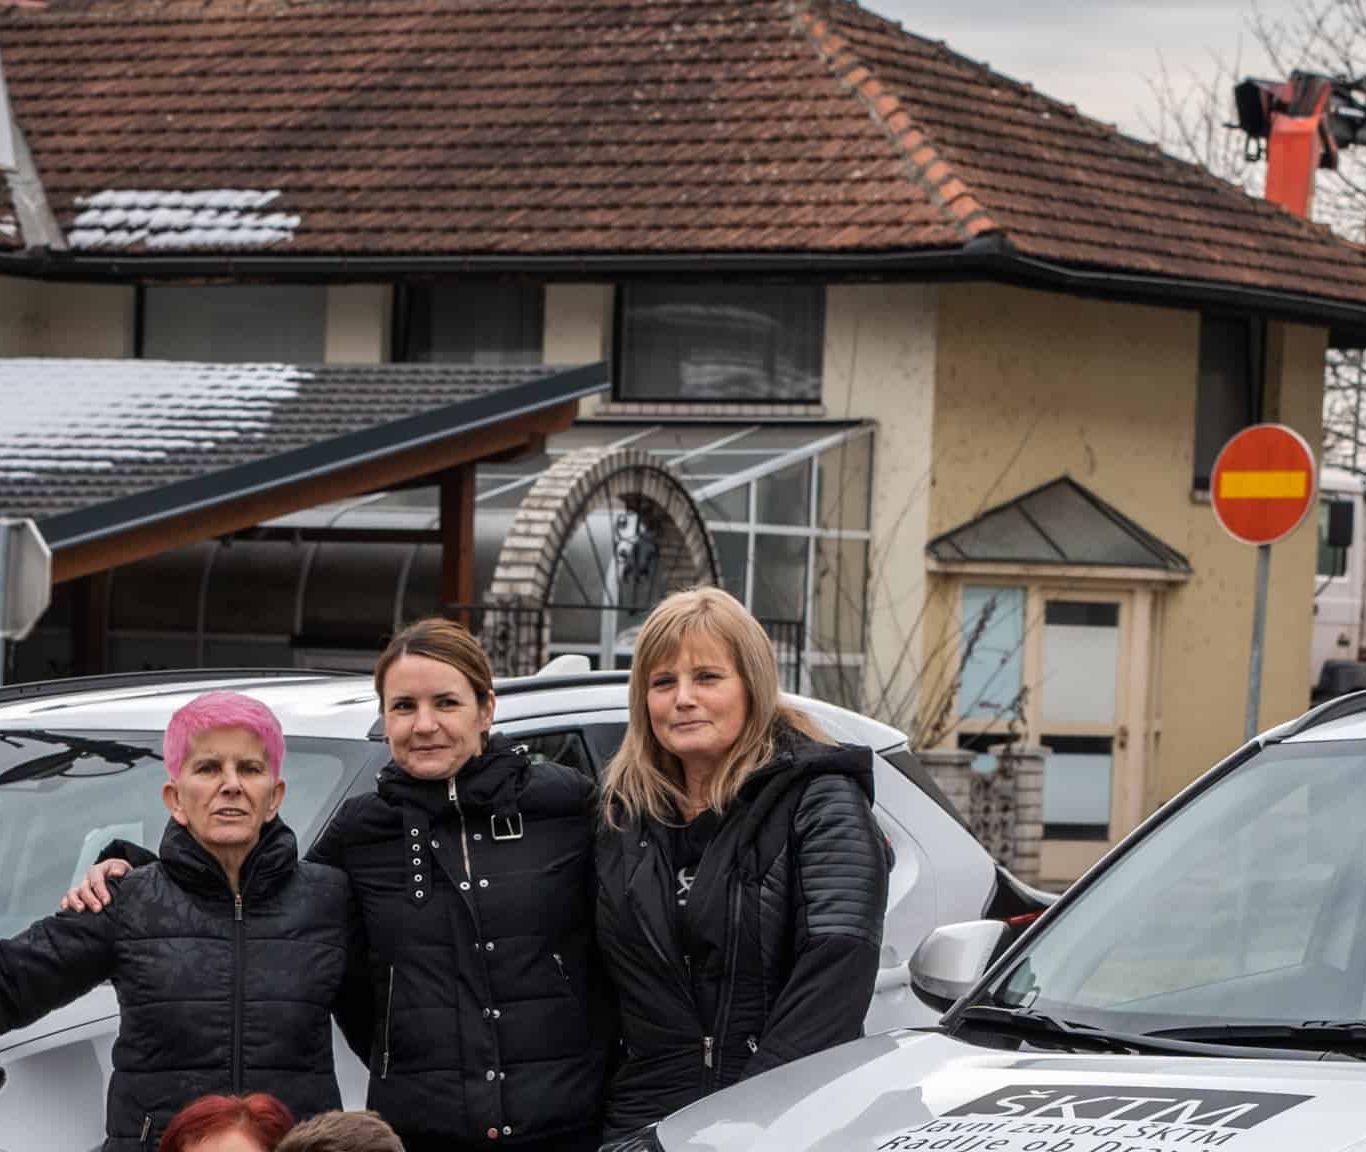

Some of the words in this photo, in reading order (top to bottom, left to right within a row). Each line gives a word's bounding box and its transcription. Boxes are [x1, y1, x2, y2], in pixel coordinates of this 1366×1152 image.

[965, 1089, 1260, 1129] ŠKTM
[907, 1119, 1014, 1133] Javni
[1008, 1121, 1128, 1138] zavod
[1122, 1123, 1237, 1146] ŠKTM
[1022, 1138, 1076, 1152] ob
